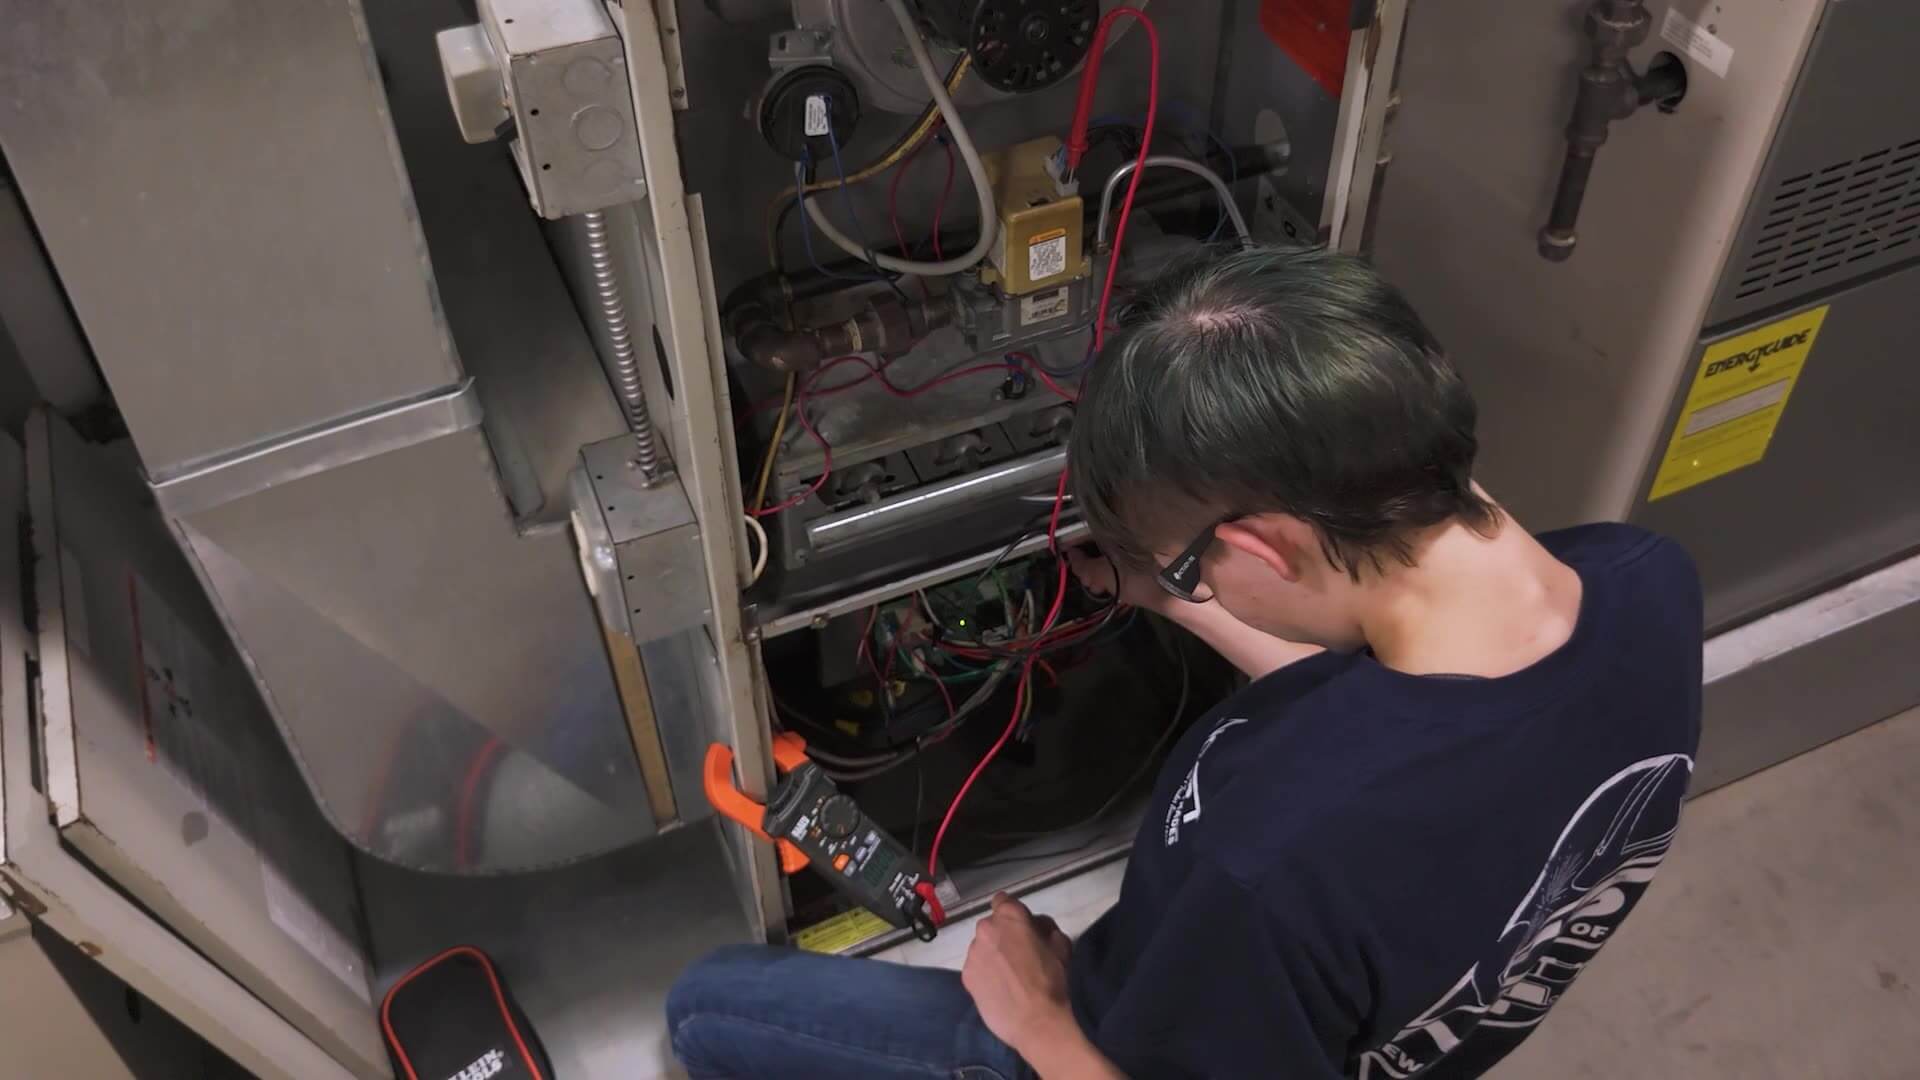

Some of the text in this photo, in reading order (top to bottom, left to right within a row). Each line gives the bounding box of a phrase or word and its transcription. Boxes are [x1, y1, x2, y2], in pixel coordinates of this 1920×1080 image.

[1570, 922, 1609, 939] OF
[447, 1048, 500, 1080] LEIN
[1381, 1043, 1424, 1072] EW
